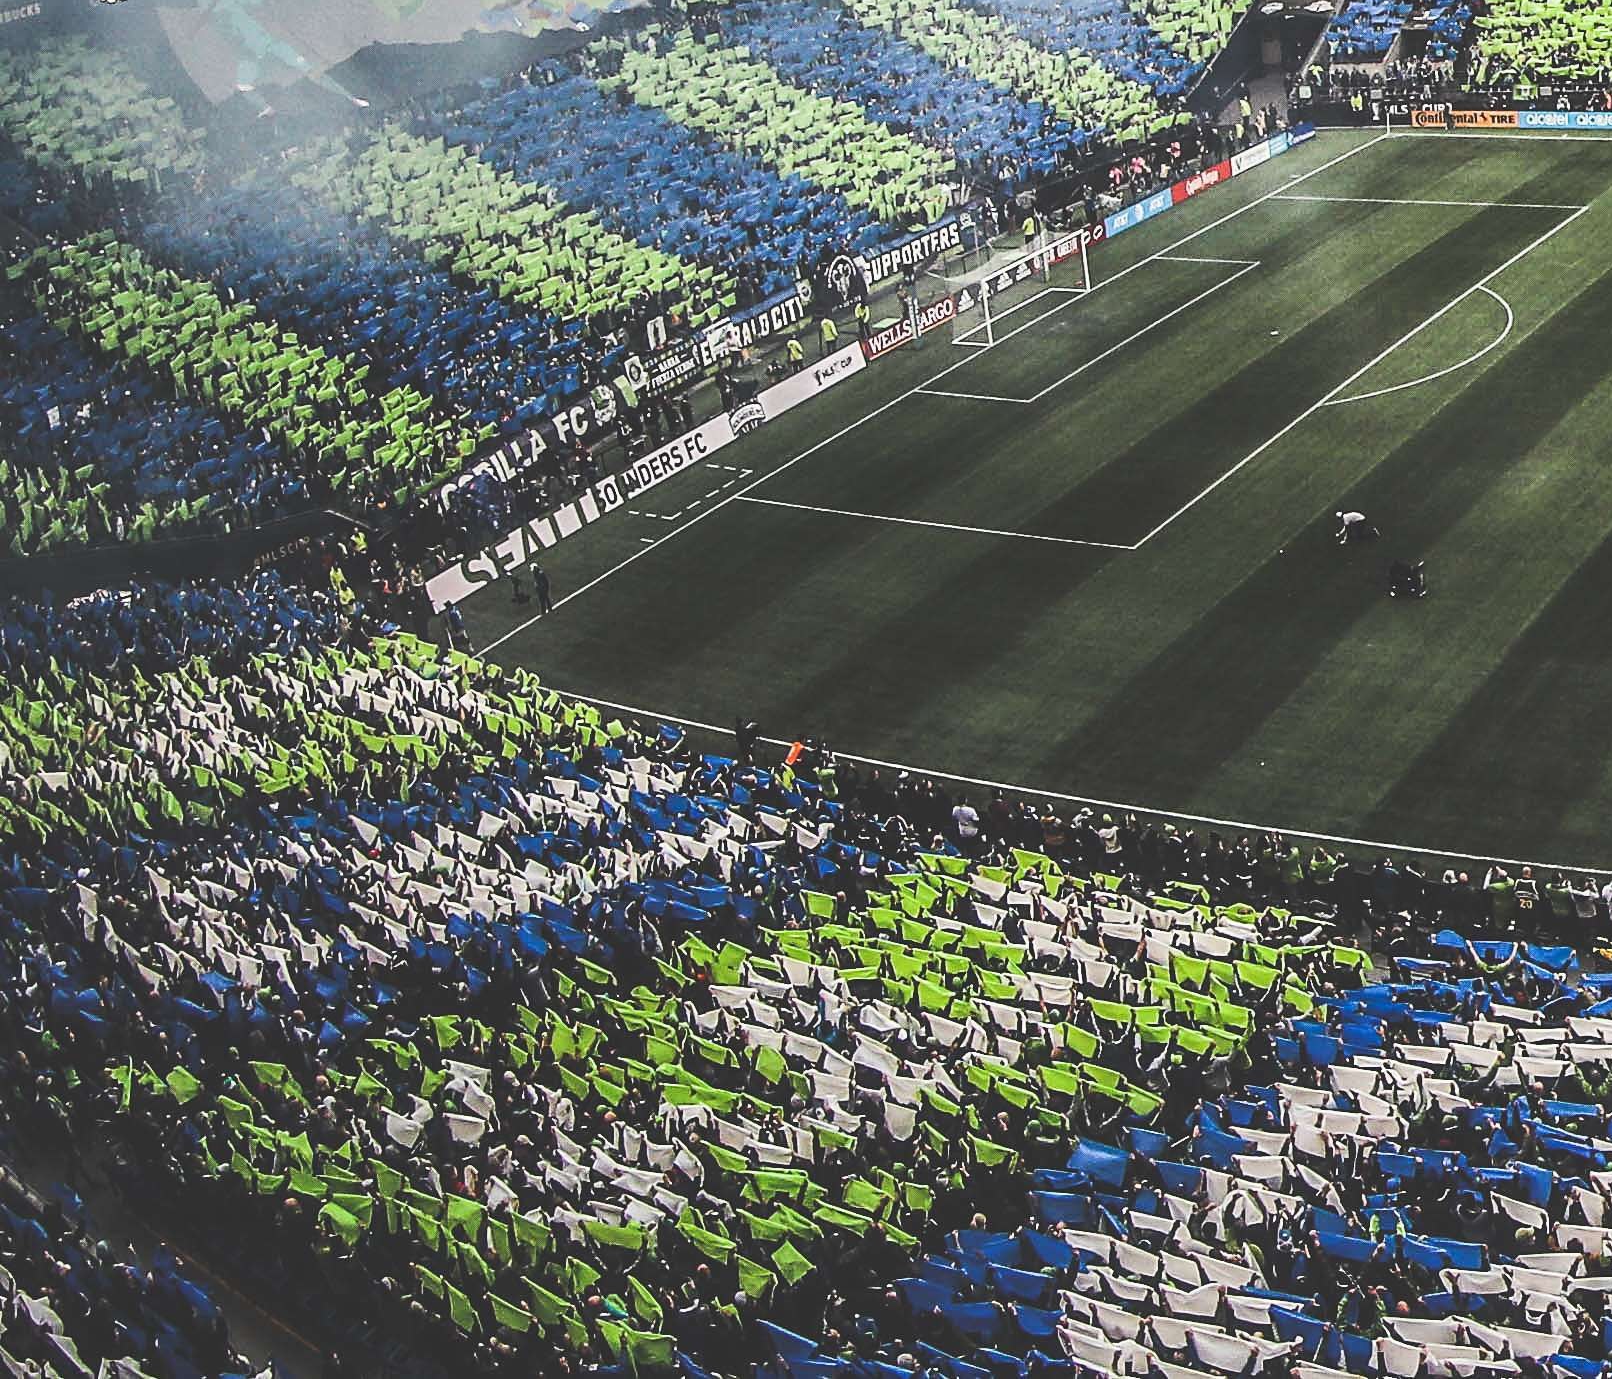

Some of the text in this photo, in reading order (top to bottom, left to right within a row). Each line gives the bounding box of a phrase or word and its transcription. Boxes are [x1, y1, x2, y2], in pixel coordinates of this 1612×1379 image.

[1415, 111, 1515, 127] Contiental TIRE
[858, 222, 961, 286] SUPPORTERS
[771, 296, 804, 330] CITY
[868, 299, 954, 354] WELLS ARGO
[552, 406, 588, 443] FC
[685, 433, 707, 455] FC
